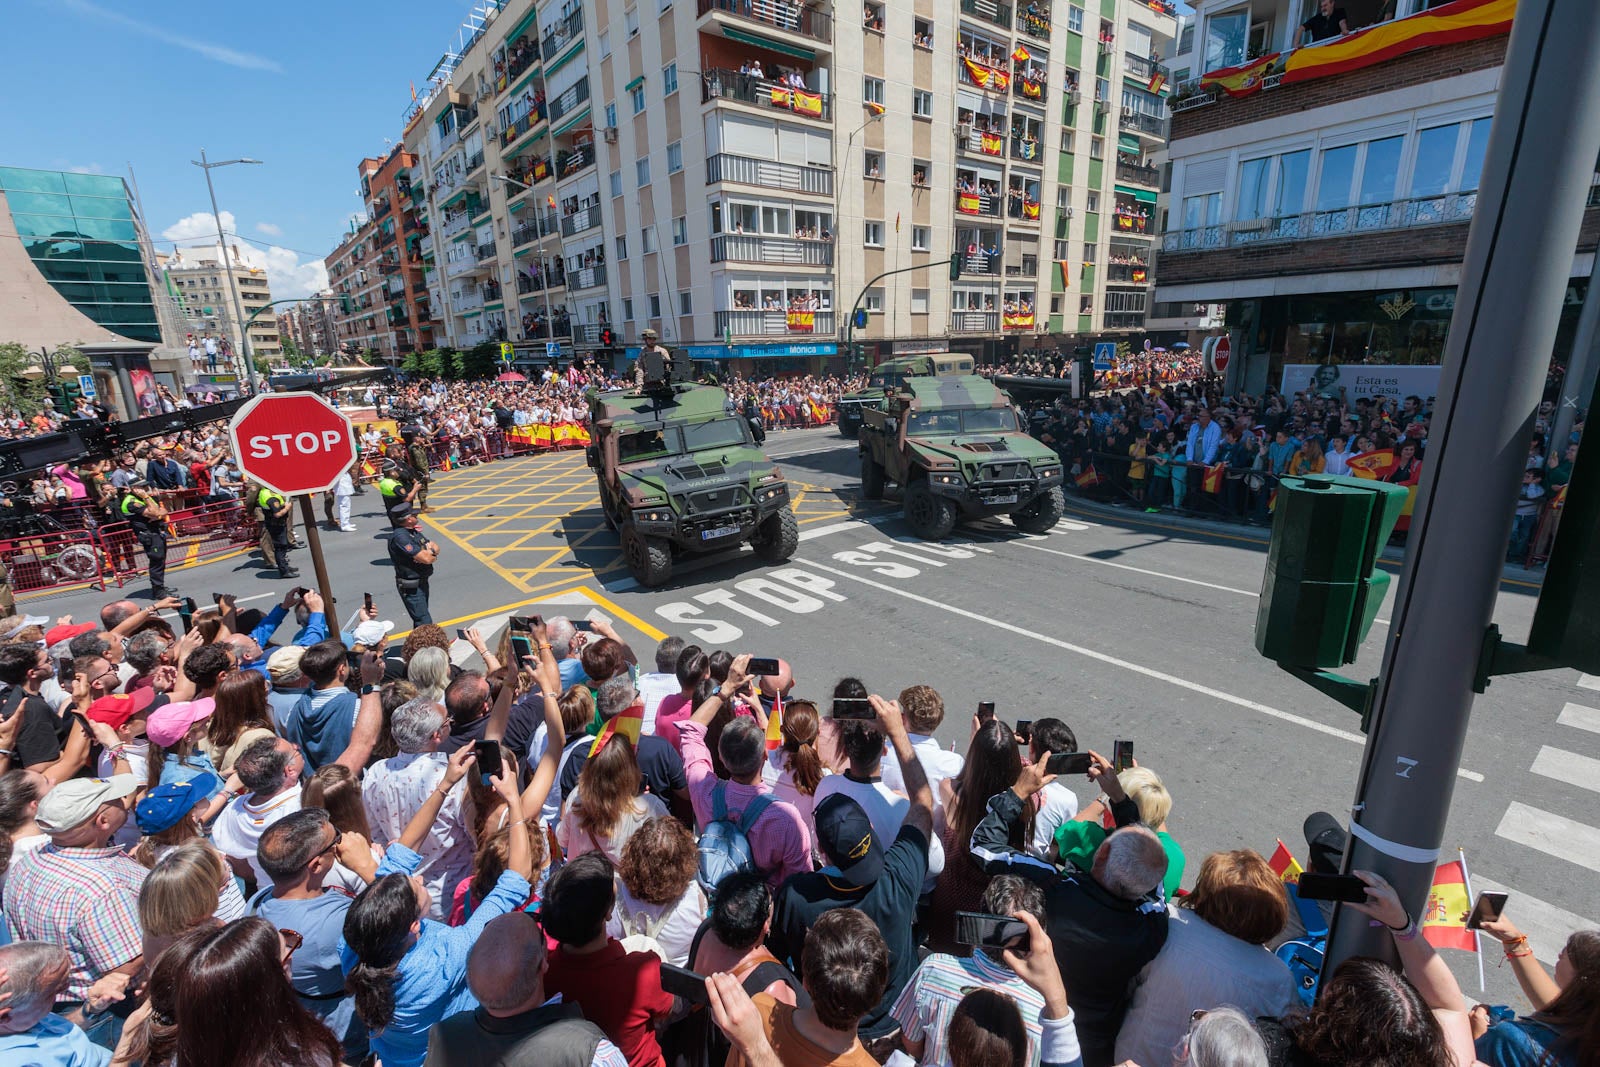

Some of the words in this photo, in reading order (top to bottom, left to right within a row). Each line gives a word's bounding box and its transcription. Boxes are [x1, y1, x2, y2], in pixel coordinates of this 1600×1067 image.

[1216, 350, 1229, 359] STOP
[1356, 376, 1381, 385] Esta
[1369, 386, 1401, 395] Casa.
[249, 430, 341, 459] STOP
[655, 568, 848, 645] STOP
